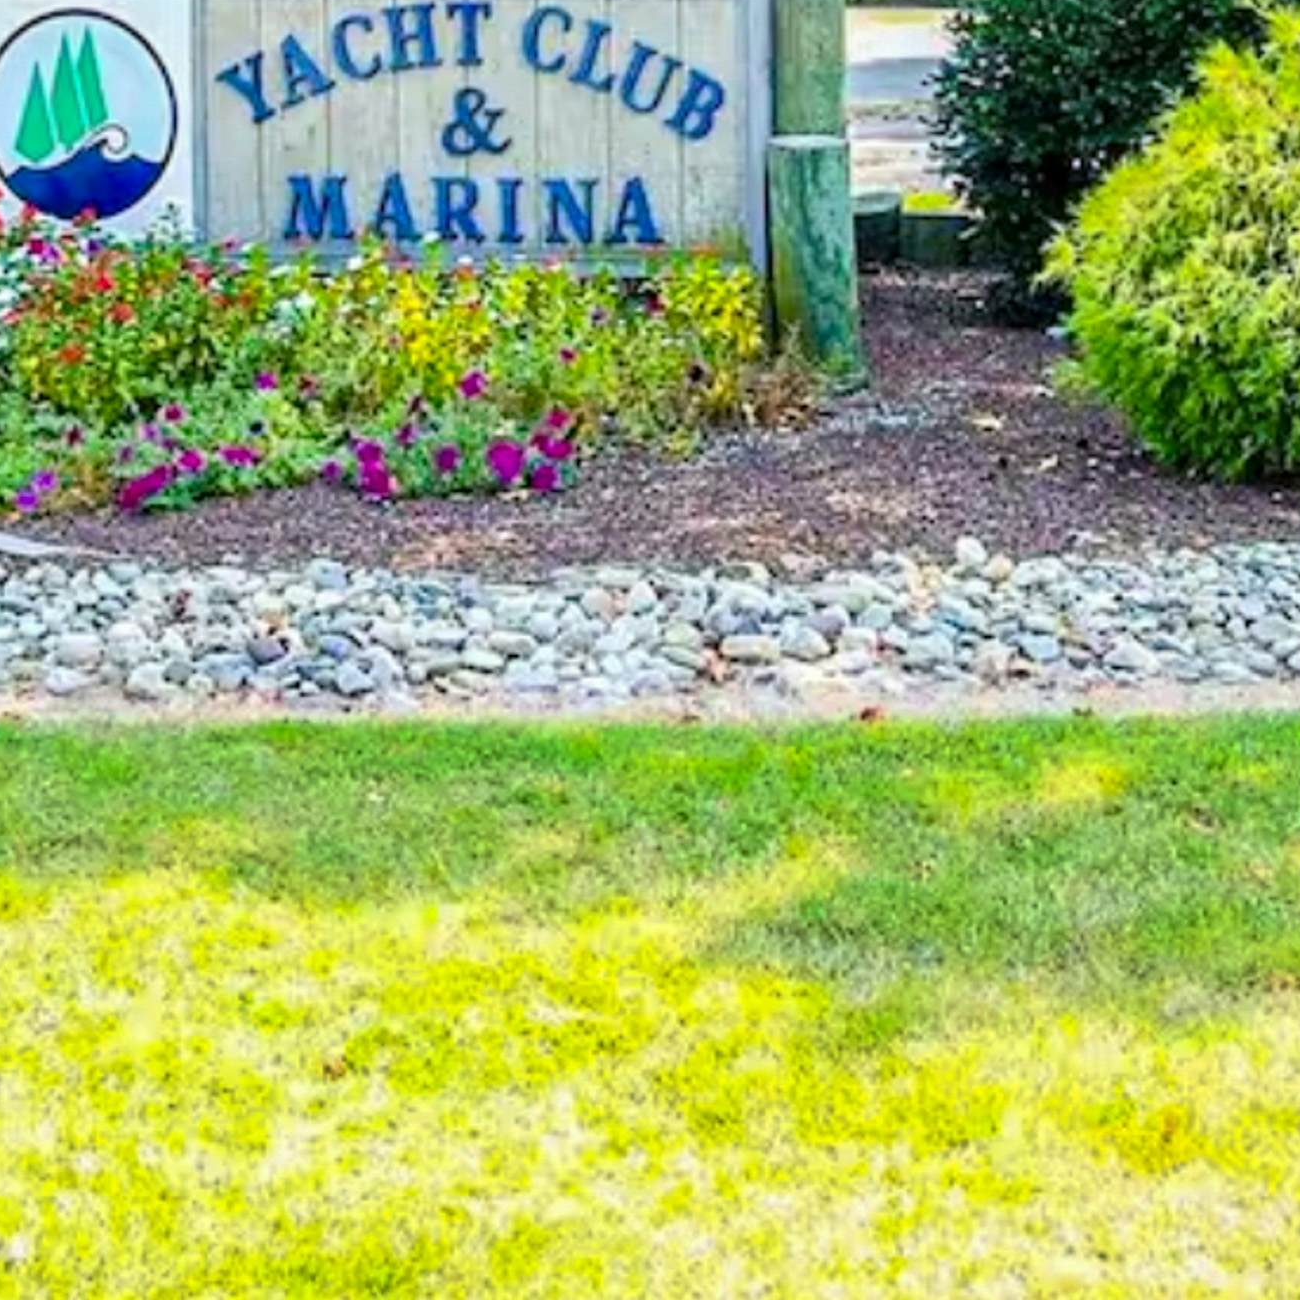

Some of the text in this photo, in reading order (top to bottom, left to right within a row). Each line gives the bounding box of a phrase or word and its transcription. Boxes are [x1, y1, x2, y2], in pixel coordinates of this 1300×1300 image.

[215, 0, 727, 141] YACHT CLUB
[440, 87, 513, 156] &
[282, 173, 665, 244] MARINA
